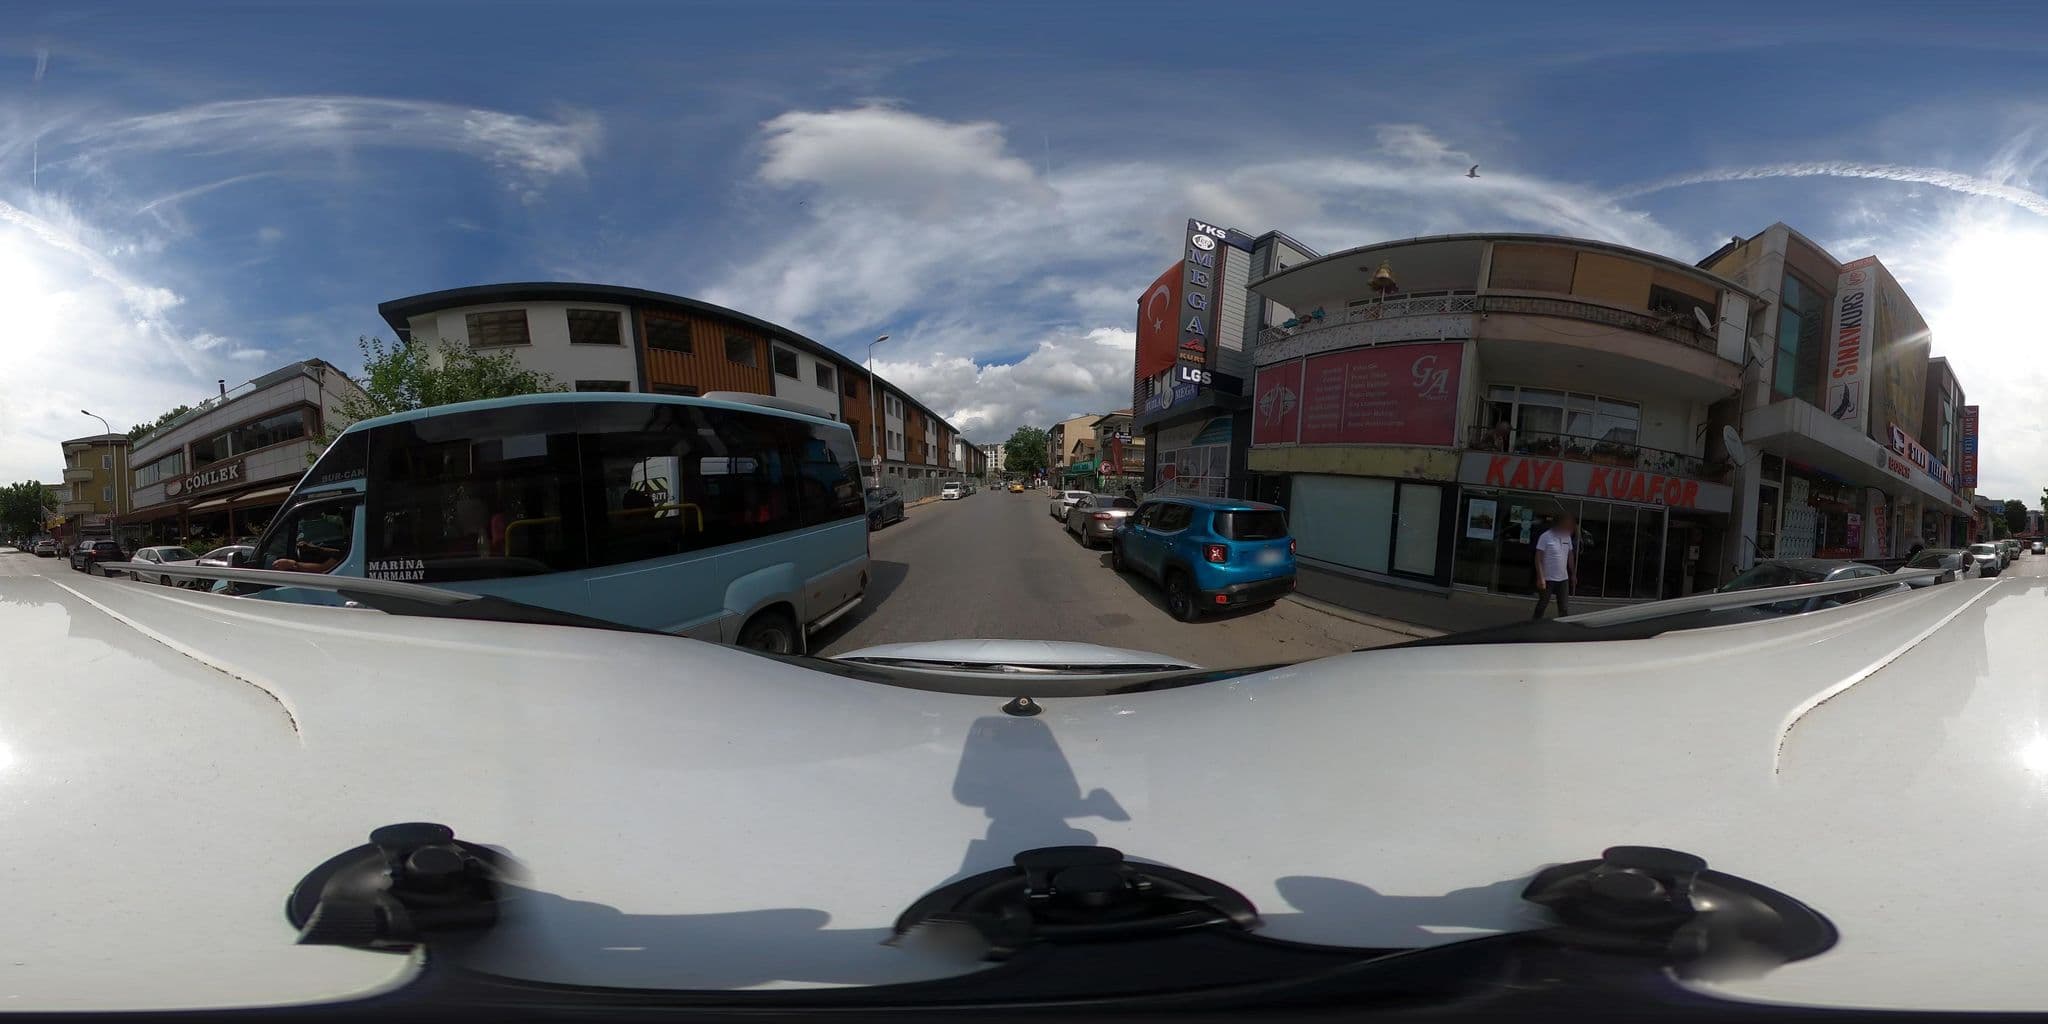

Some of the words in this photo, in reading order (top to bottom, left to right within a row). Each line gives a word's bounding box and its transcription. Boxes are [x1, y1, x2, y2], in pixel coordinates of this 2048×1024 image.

[1195, 222, 1227, 239] YKS
[1186, 248, 1214, 335] MEGA
[1182, 366, 1212, 385] LGS
[185, 465, 239, 494] ÇÖMLEK
[1487, 455, 1565, 492] KAYA
[368, 557, 424, 571] MARİNA
[368, 570, 424, 580] MARMARAY
